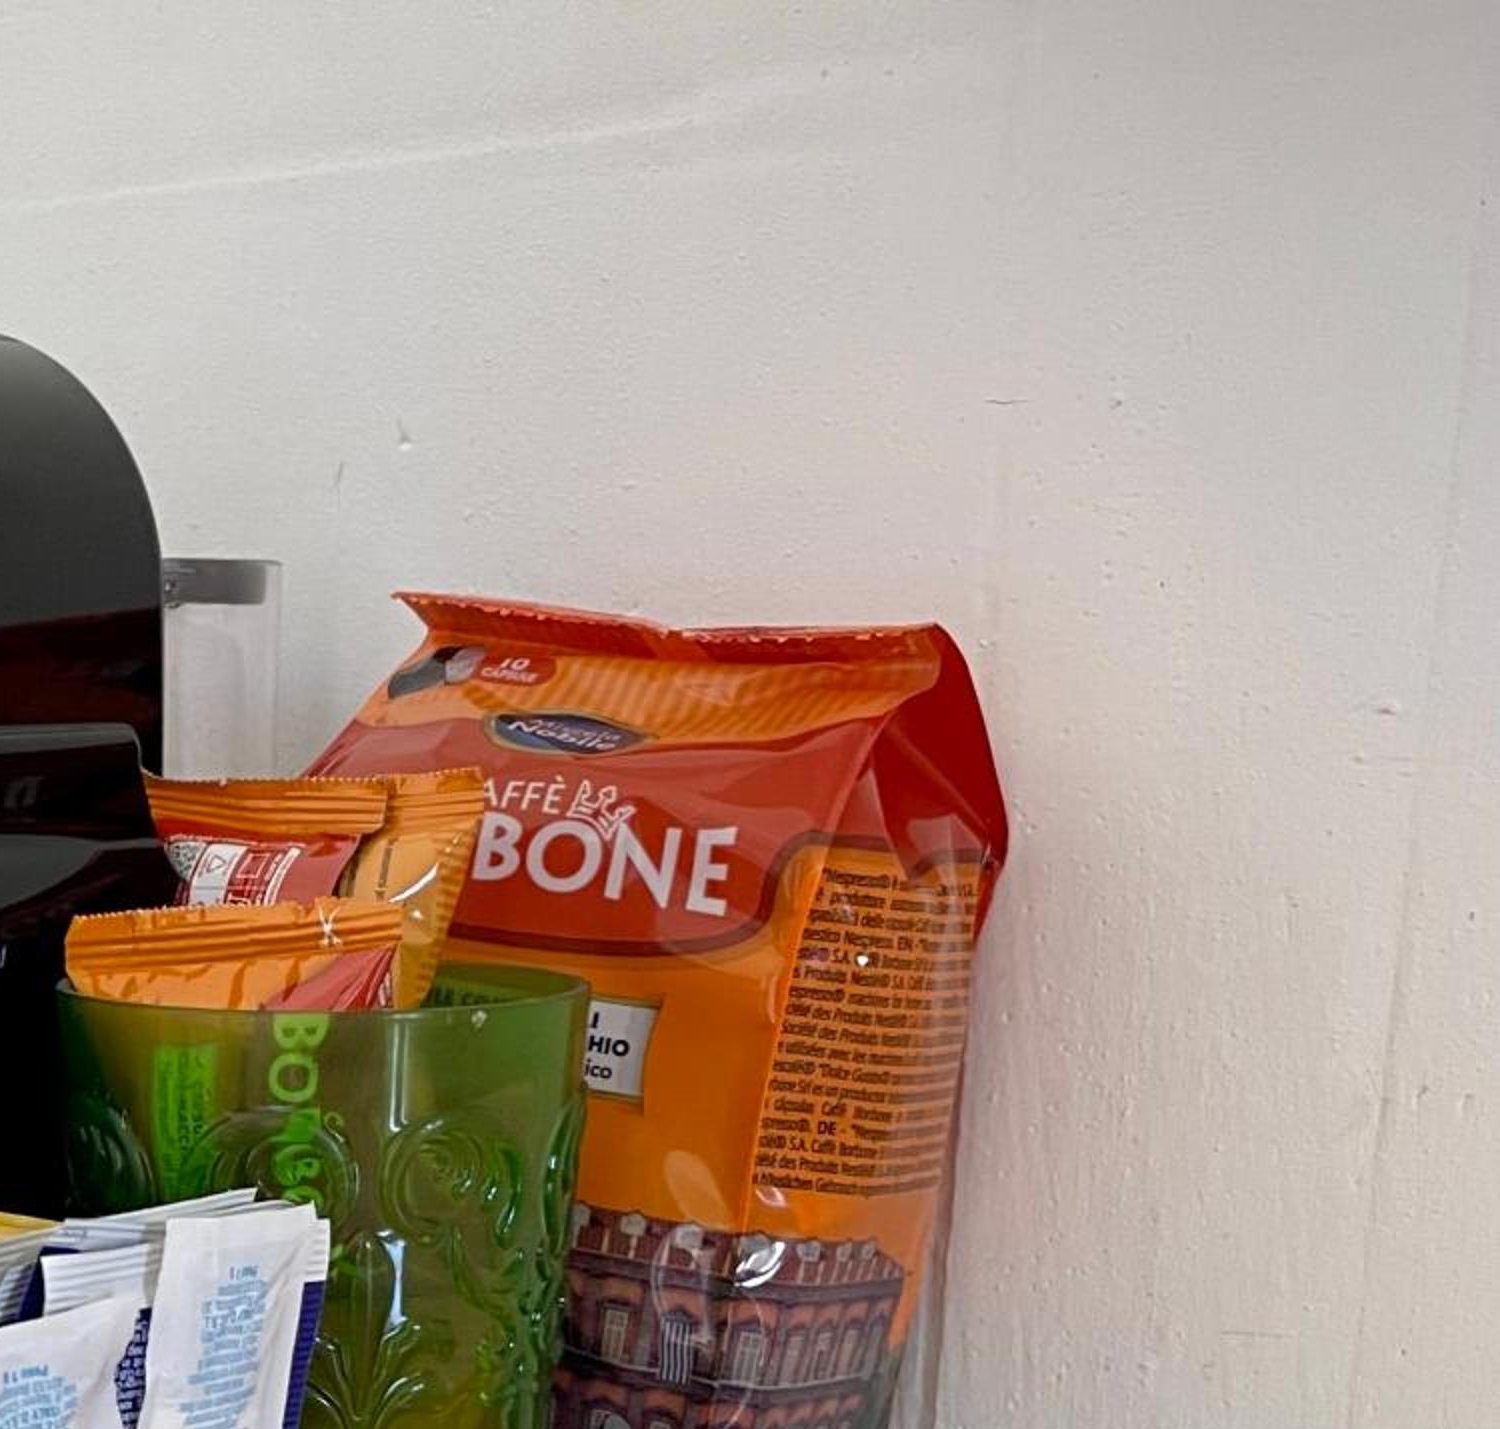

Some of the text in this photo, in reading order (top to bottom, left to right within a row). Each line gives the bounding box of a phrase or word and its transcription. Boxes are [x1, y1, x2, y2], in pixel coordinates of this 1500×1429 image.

[500, 657, 530, 670] 10
[507, 720, 616, 750] Nobile
[588, 1035, 630, 1056] HIO
[584, 1058, 613, 1079] ico
